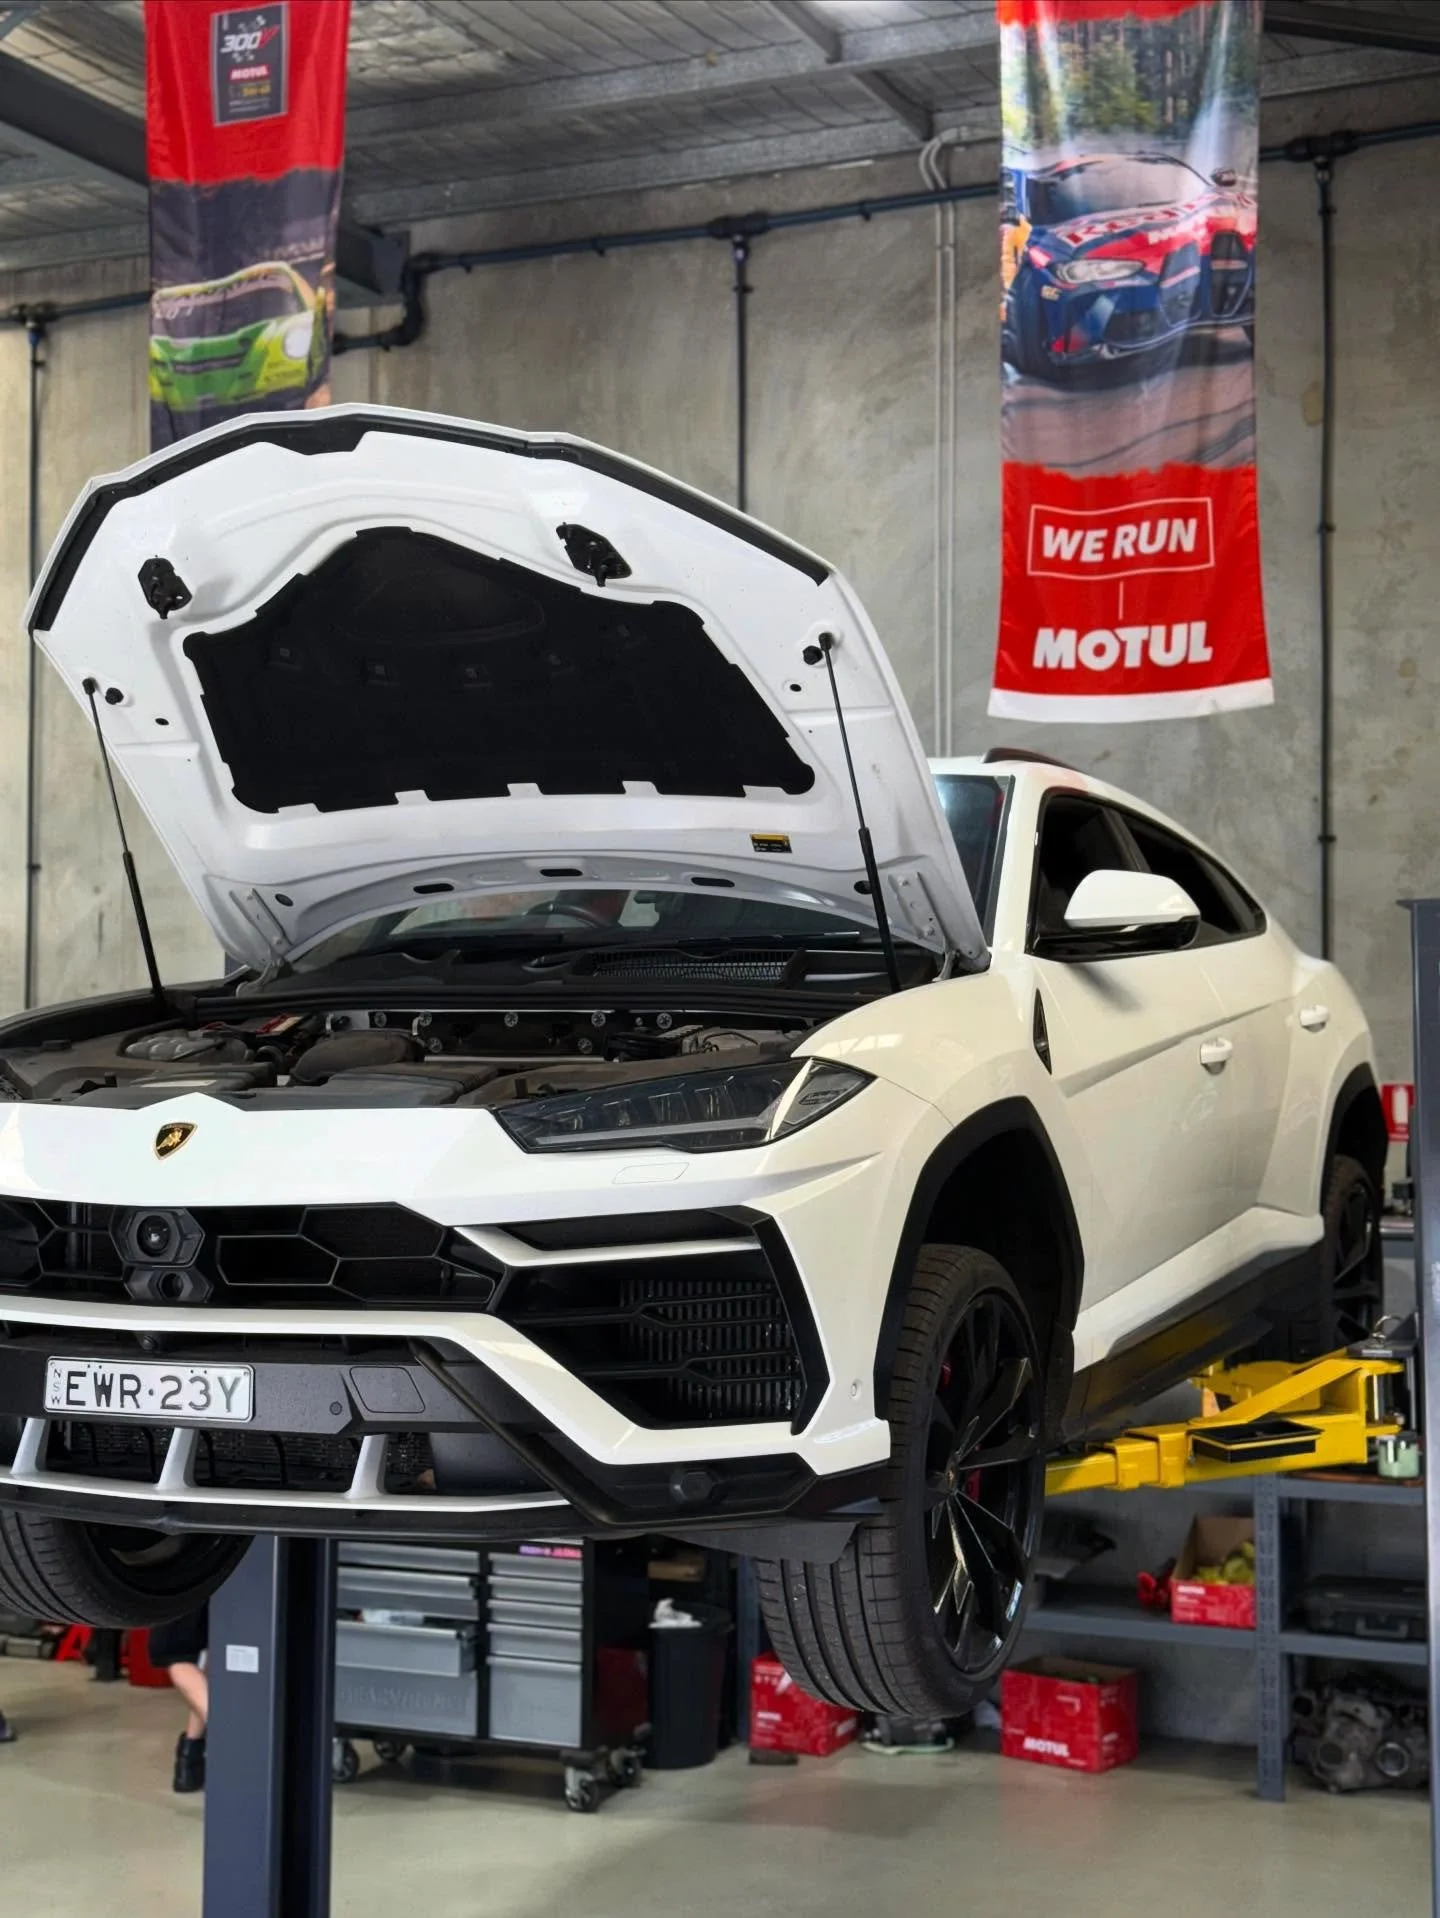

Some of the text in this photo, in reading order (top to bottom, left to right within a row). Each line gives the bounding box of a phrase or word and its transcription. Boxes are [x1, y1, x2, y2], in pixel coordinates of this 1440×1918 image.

[1042, 518, 1198, 563] WE RUN
[1032, 620, 1214, 671] MOTUL
[1022, 1737, 1070, 1758] MOTUL
